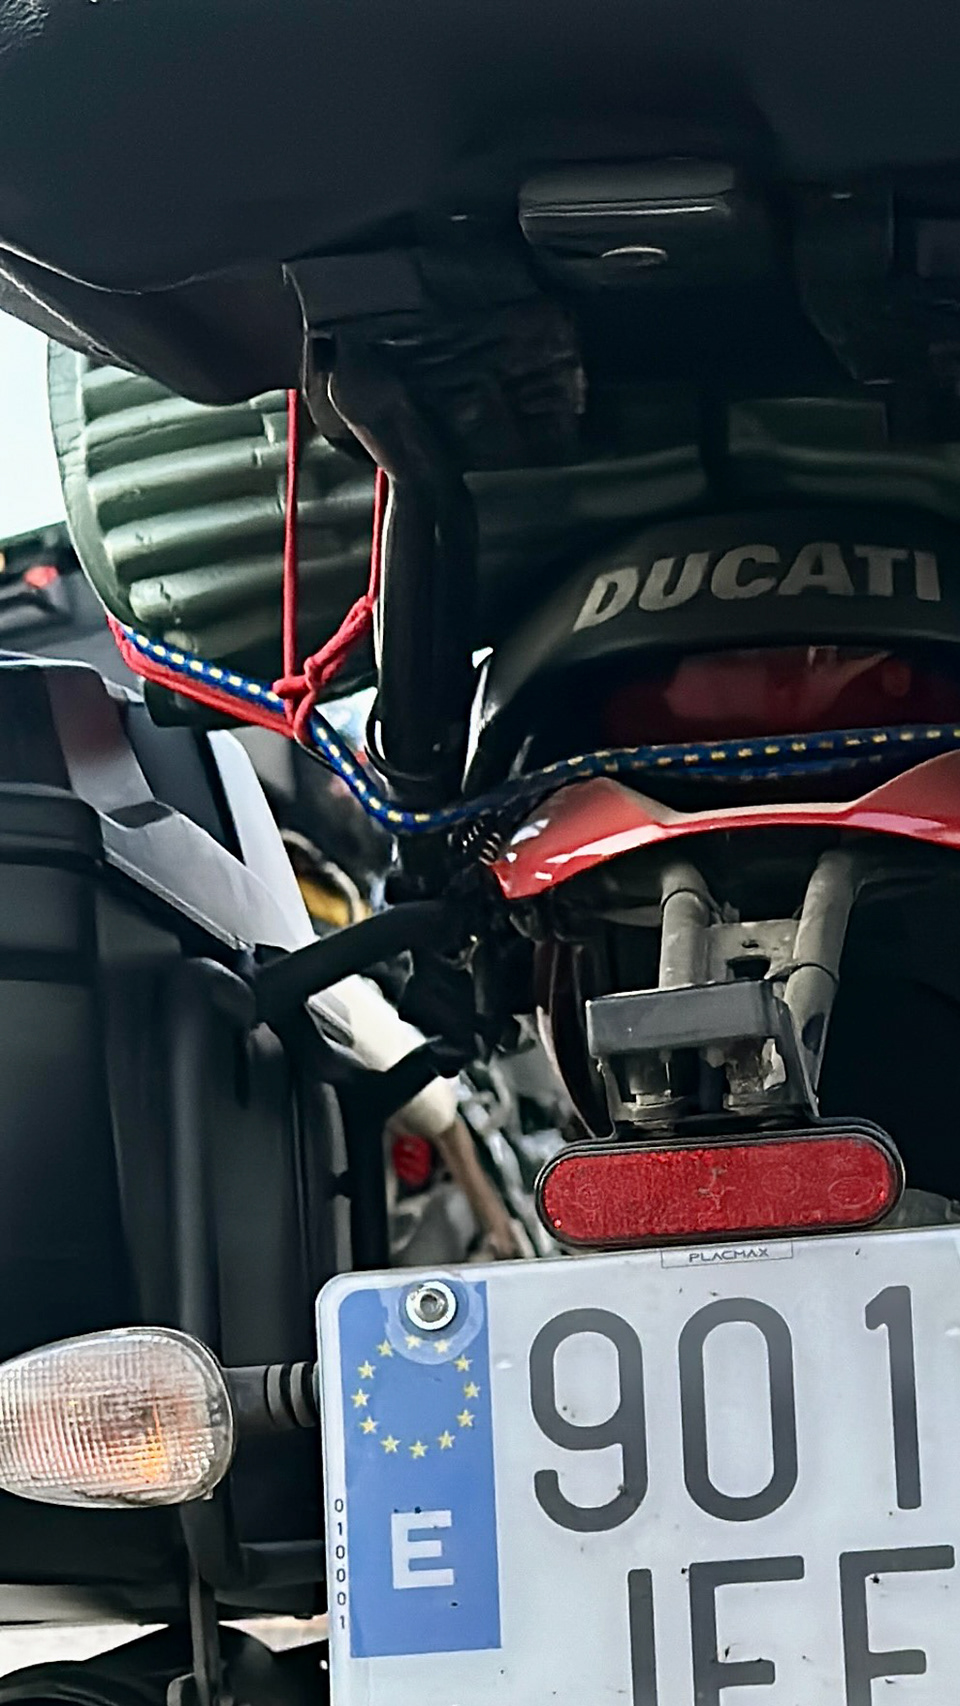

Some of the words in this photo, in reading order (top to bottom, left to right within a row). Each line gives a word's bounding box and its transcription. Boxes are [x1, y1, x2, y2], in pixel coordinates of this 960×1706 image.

[573, 541, 941, 632] DUCATI
[688, 1248, 769, 1263] PLACMAX
[391, 1511, 454, 1590] E
